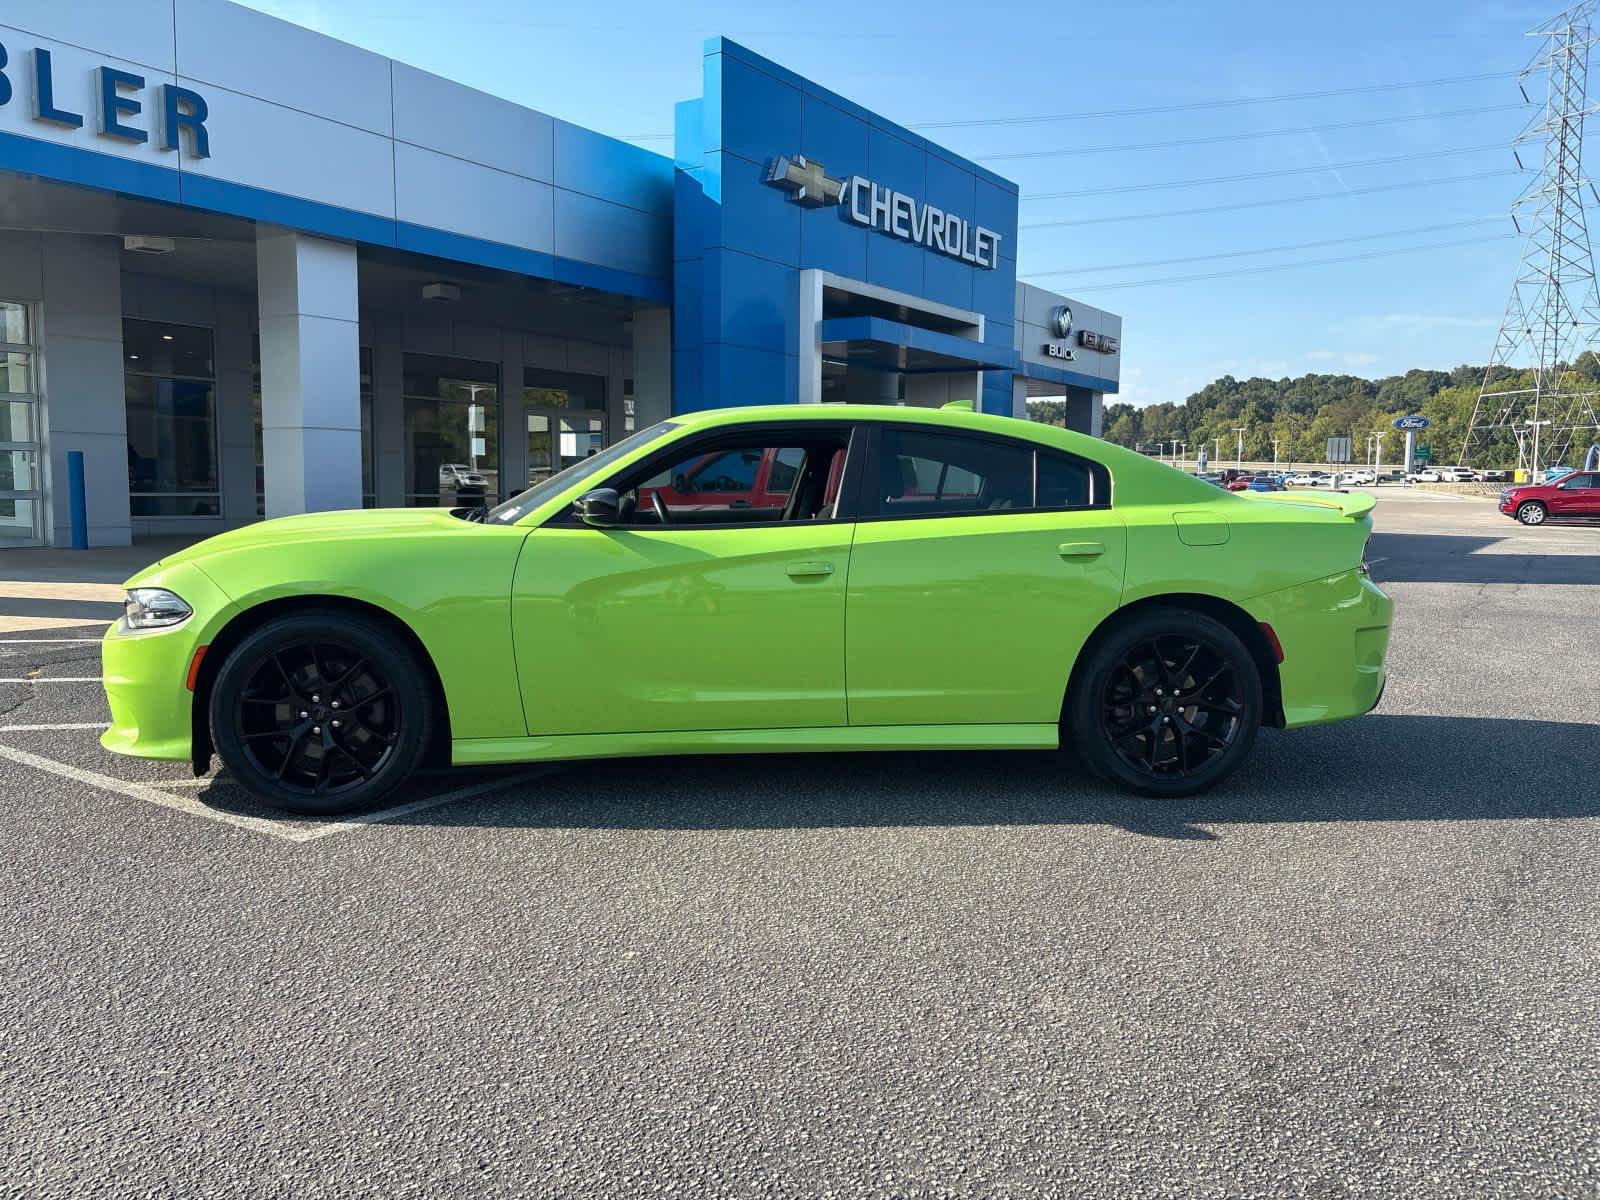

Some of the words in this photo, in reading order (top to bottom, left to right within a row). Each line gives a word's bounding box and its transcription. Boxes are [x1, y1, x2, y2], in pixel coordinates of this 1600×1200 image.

[0, 42, 210, 159] LER
[852, 175, 1001, 269] CHEVROLET
[1048, 343, 1078, 361] BUICK
[1081, 330, 1117, 353] GMC
[1400, 418, 1426, 428] Ford
